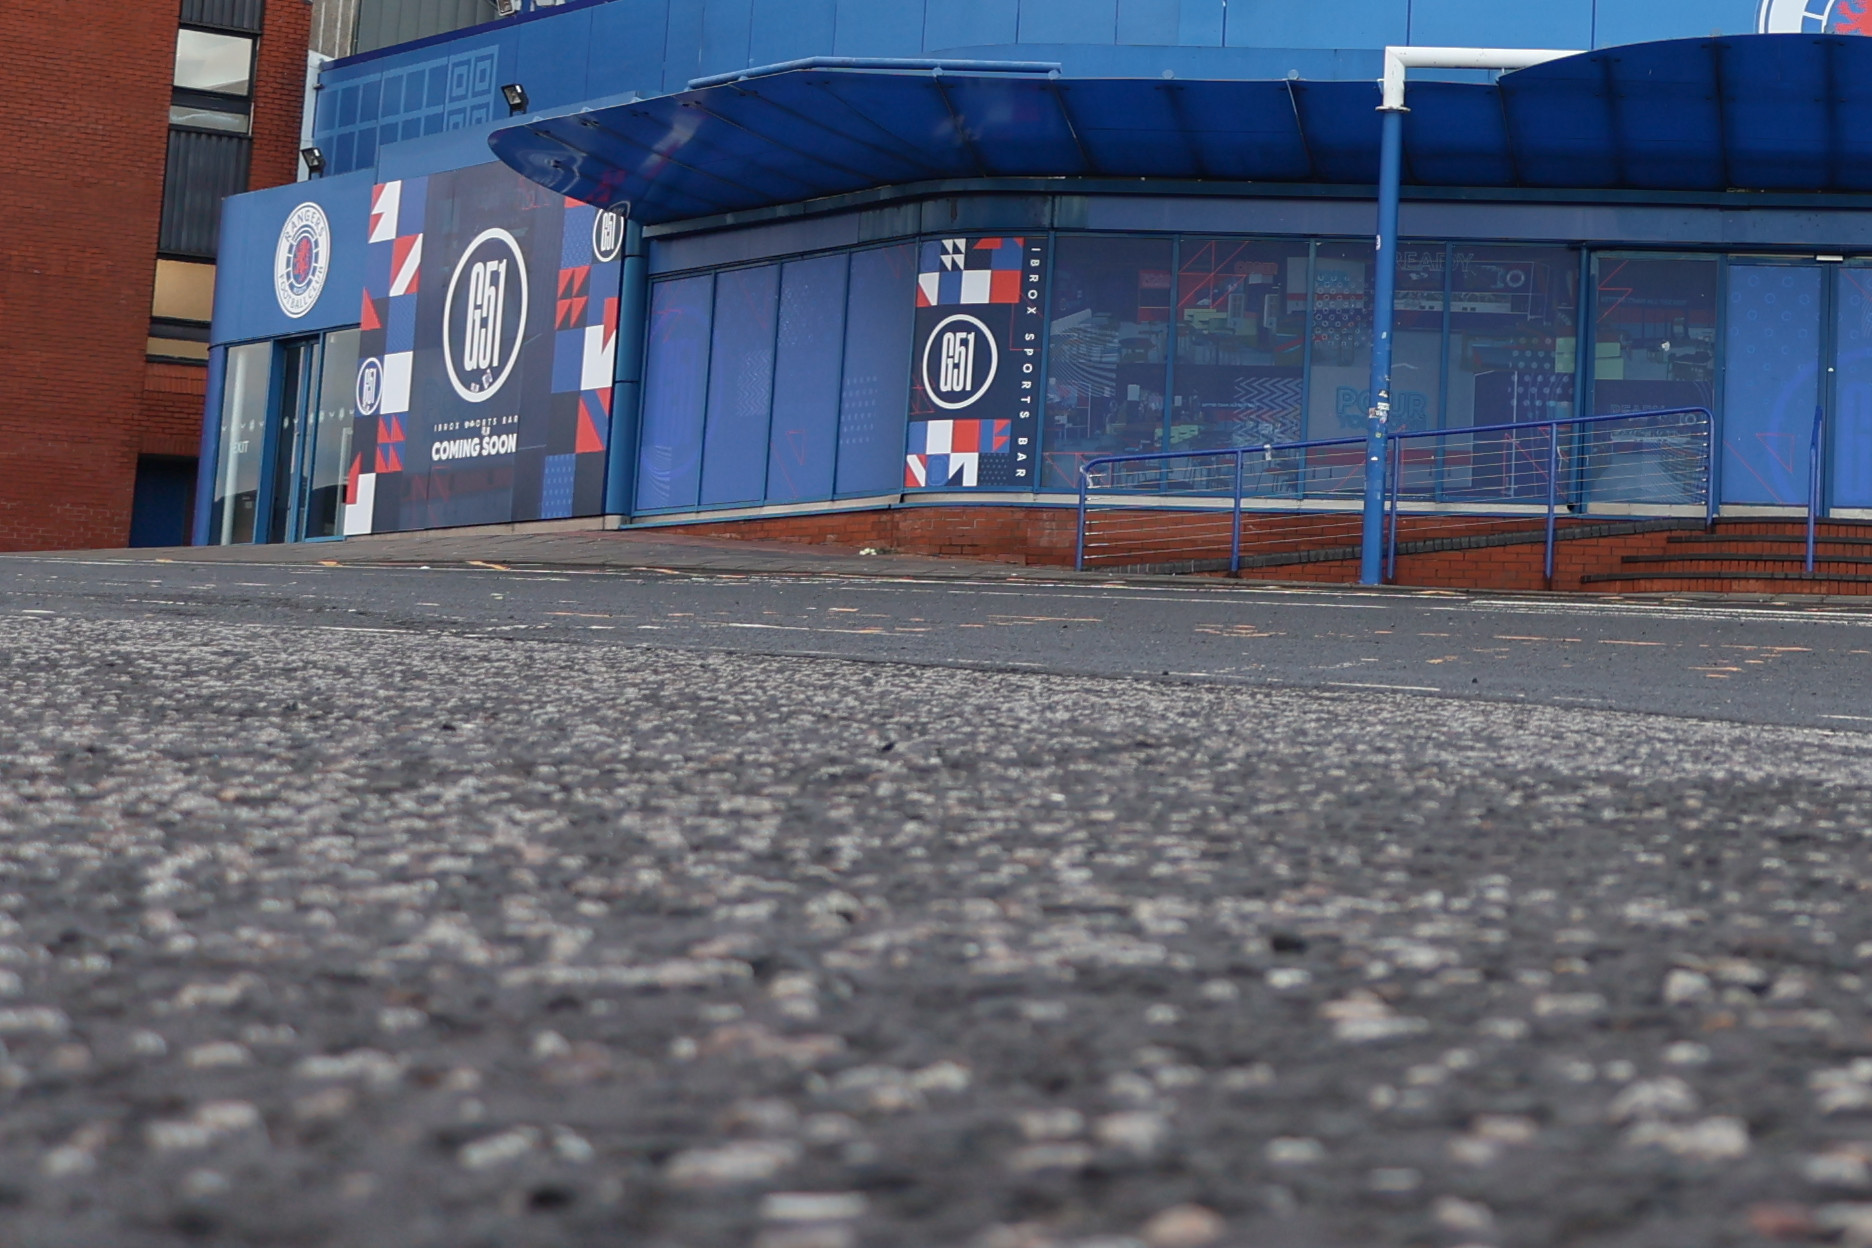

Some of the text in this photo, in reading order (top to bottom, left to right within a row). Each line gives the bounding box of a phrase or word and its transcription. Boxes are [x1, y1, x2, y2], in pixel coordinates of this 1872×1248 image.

[284, 209, 325, 243] RANGERS
[600, 212, 616, 252] G51
[464, 258, 507, 372] G51
[939, 330, 976, 393] G51
[1016, 247, 1041, 478] IBROX SPORTS BAR
[432, 433, 518, 461] COMING SOON
